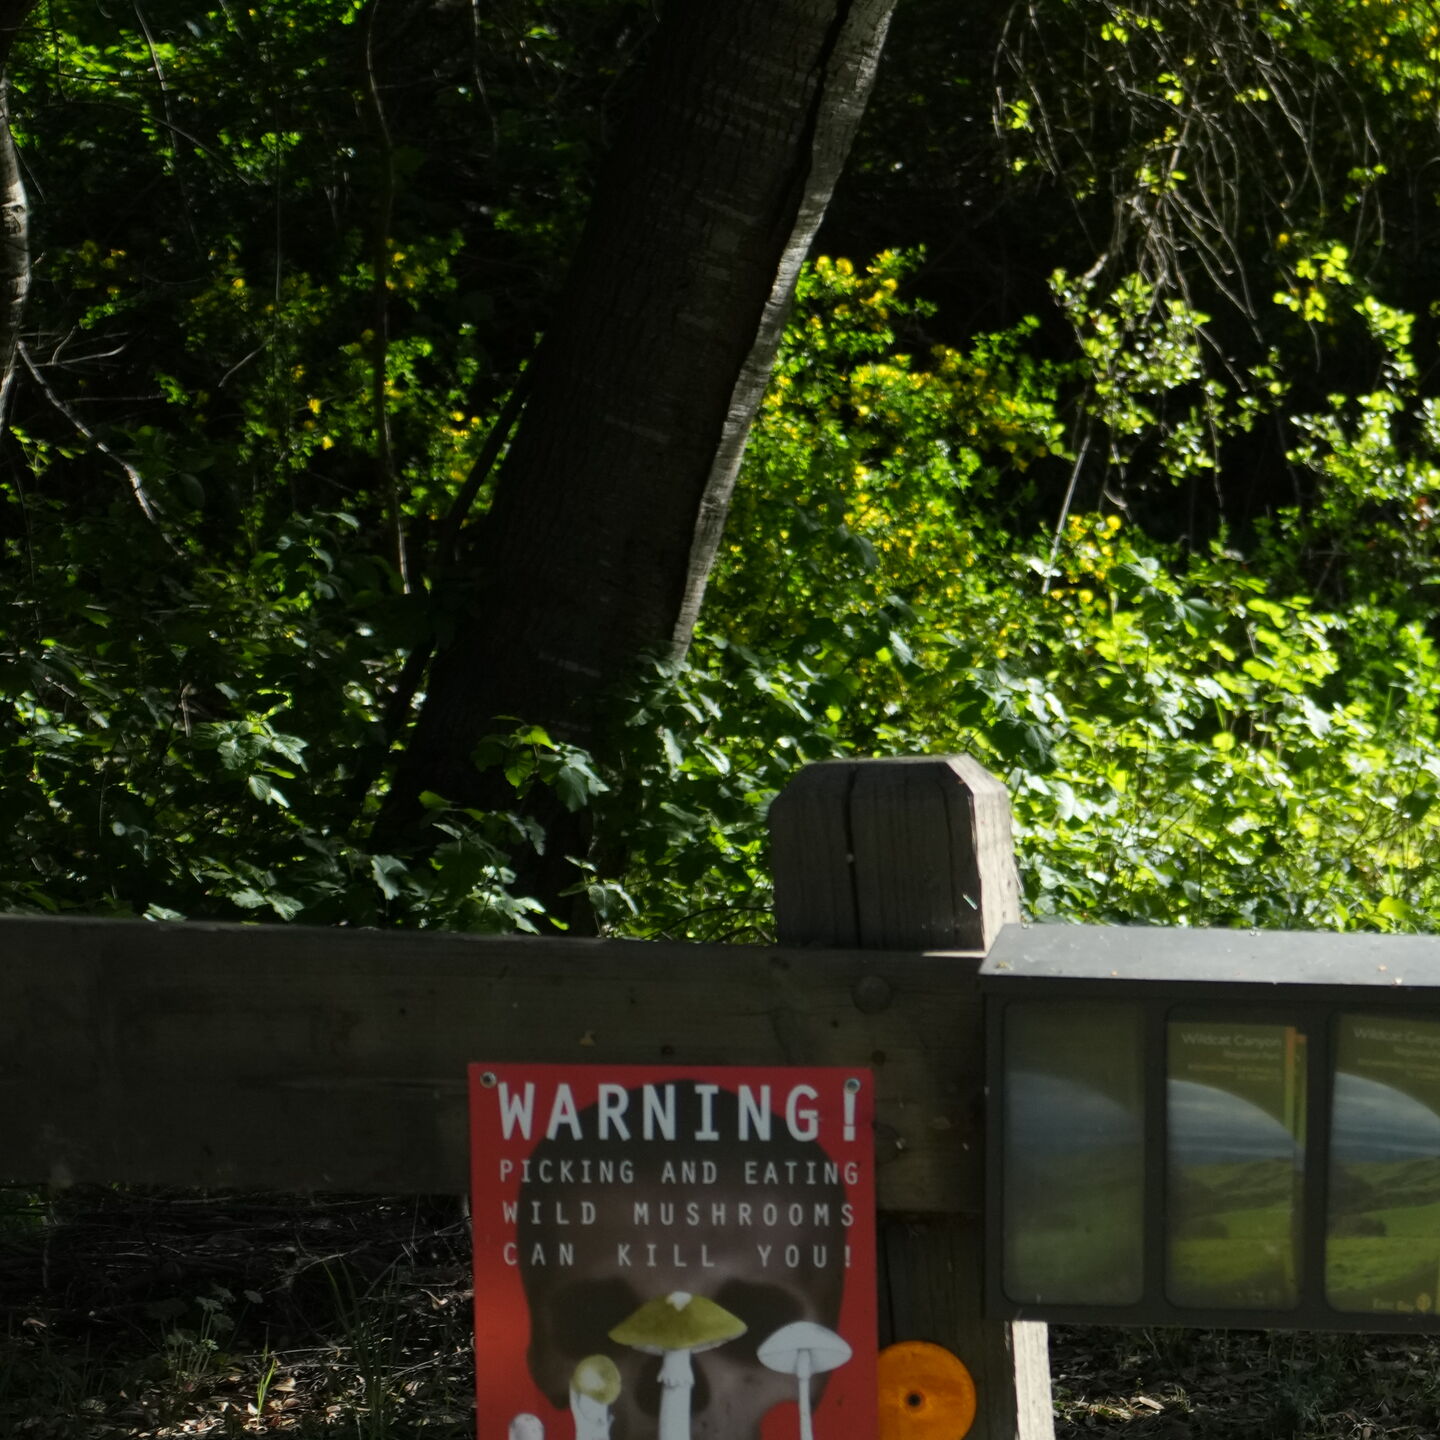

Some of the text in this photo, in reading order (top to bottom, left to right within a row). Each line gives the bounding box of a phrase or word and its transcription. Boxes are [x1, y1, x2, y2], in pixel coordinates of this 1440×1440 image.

[497, 1082, 857, 1142] WARNING!
[500, 1159, 858, 1185] PICKING AND EATING
[503, 1201, 855, 1226] WILD MUSHROOMS
[504, 1243, 853, 1268] CAN KILL YOU!
